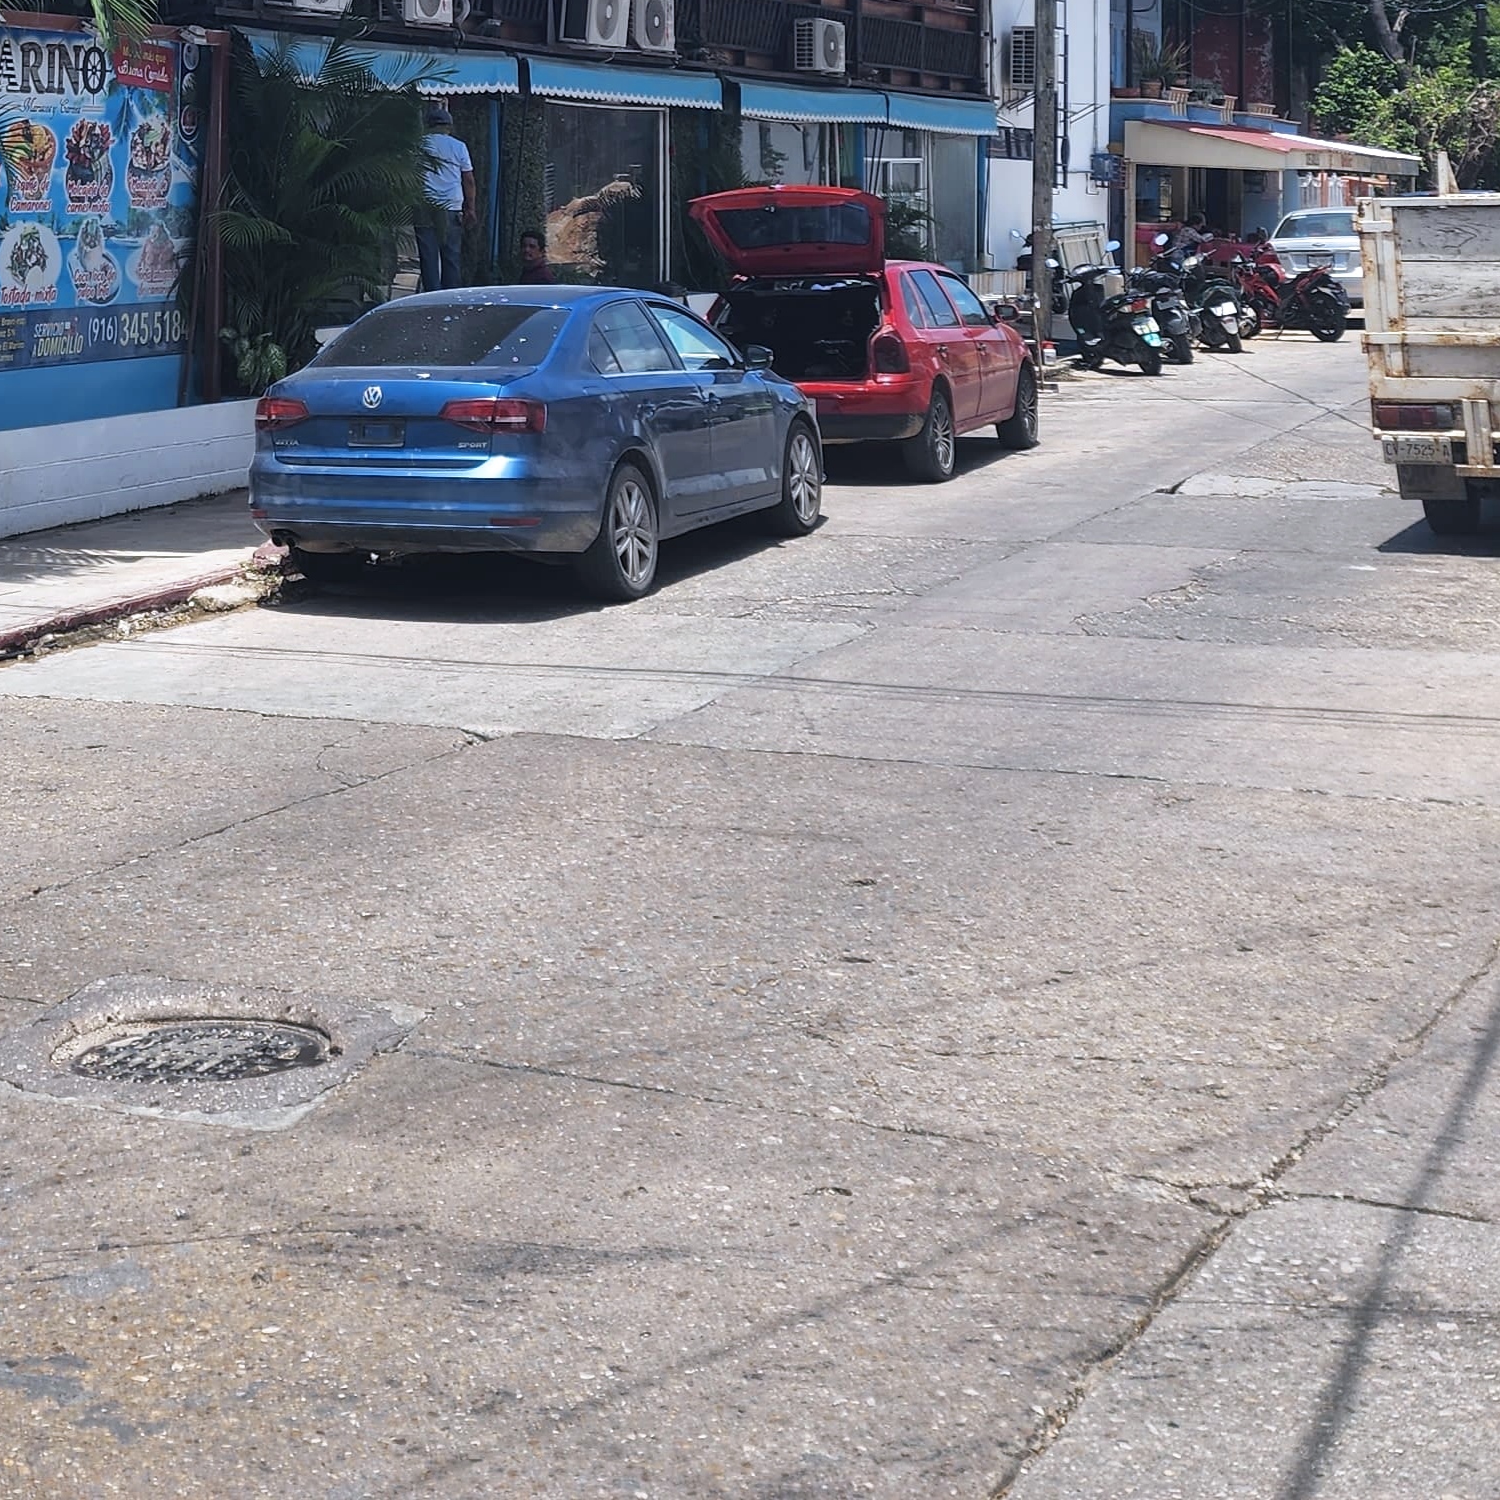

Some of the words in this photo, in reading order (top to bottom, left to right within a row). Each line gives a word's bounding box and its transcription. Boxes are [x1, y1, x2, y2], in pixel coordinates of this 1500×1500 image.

[34, 322, 63, 338] SERVICIO
[88, 316, 118, 348] (916)
[120, 312, 149, 346] 345
[37, 334, 84, 357] DOMICILIO
